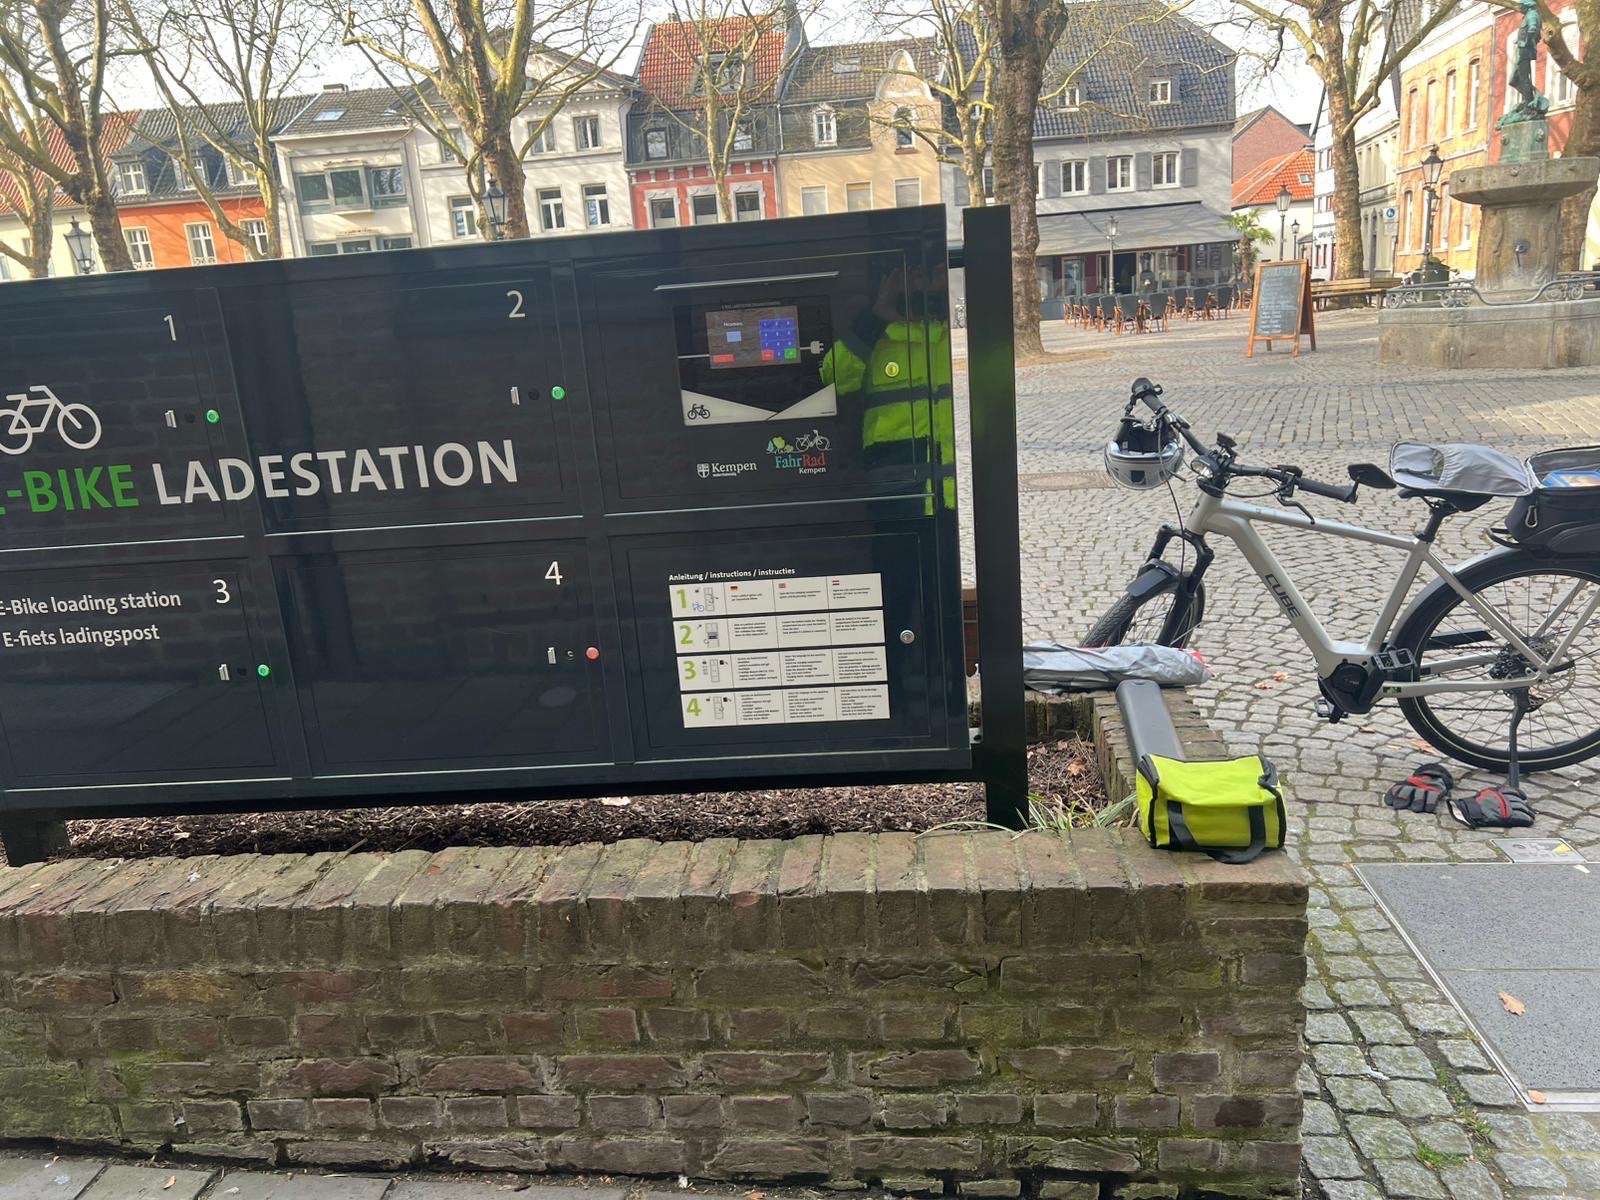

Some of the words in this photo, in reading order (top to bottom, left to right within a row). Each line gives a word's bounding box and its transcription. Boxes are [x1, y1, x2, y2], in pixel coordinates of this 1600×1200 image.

[506, 290, 526, 318] 2
[163, 315, 177, 341] 1
[711, 462, 757, 474] Kempen
[775, 452, 826, 468] FahrRad
[799, 467, 827, 475] Kempen
[0, 465, 139, 515] -BIKE
[152, 439, 518, 505] LADESTATION
[544, 561, 564, 586] 4
[669, 573, 703, 581] Anleitung
[710, 569, 752, 578] instructions
[758, 567, 795, 576] instructies
[50, 594, 118, 615] loading
[120, 591, 182, 609] station
[213, 580, 231, 604] 3
[676, 589, 687, 609] 1
[1265, 574, 1301, 618] CUBE
[2, 629, 57, 648] E-fiets
[59, 624, 161, 647] ladingspost
[679, 624, 693, 645] 2
[683, 660, 697, 680] 3
[686, 698, 702, 717] 4
